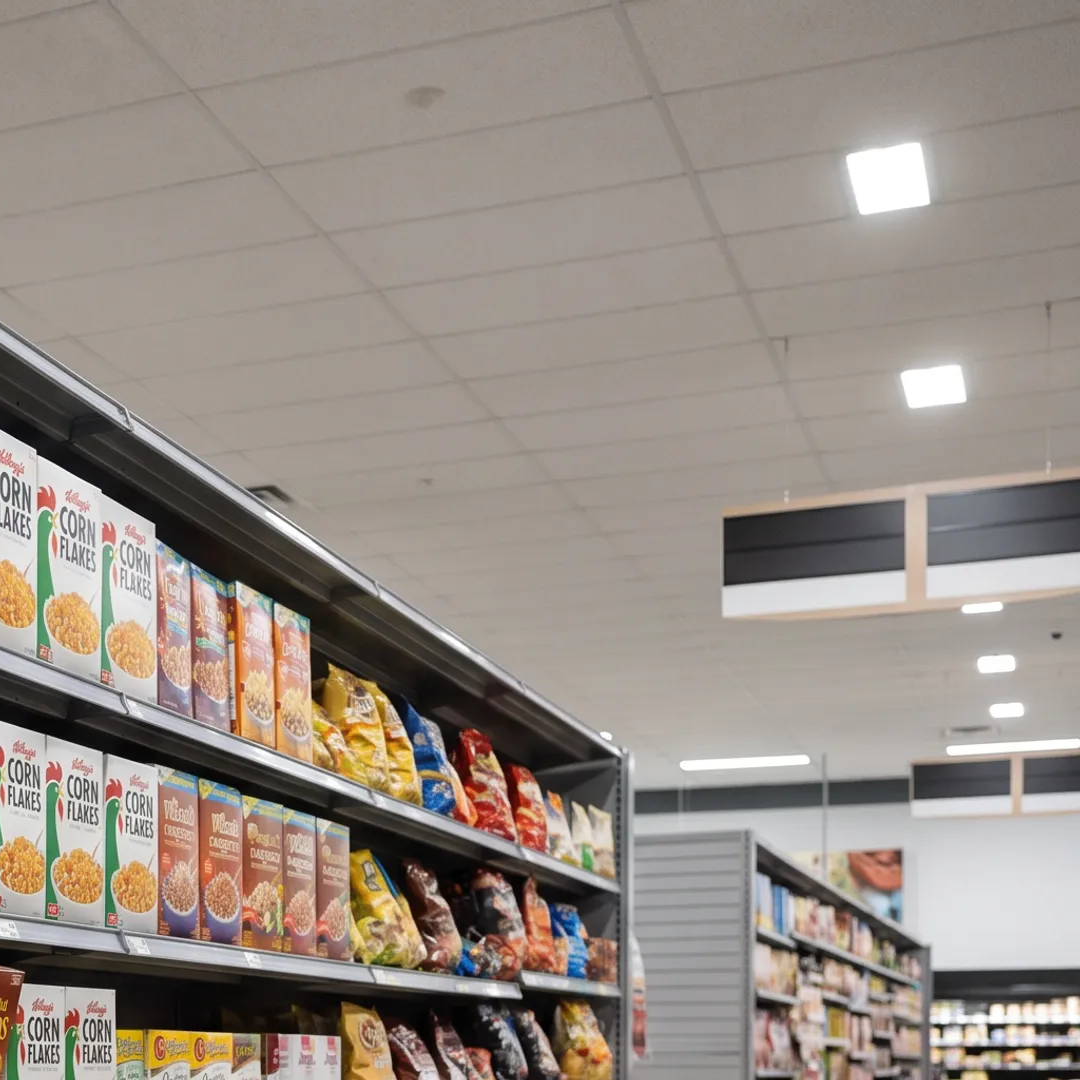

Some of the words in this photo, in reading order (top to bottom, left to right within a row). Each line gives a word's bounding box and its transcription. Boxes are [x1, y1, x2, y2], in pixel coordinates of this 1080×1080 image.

[59, 506, 96, 548] CORN
[60, 535, 96, 573] FLAKES
[120, 540, 151, 579] CORN
[120, 568, 152, 602] FLAKES
[7, 757, 41, 790] CORN
[8, 785, 42, 813] FLAKES
[67, 774, 99, 805] CORN
[67, 800, 100, 827] FLAKES
[125, 790, 153, 819] CORN
[125, 815, 154, 839] FLAKES
[27, 1016, 60, 1043] CORN
[82, 1017, 112, 1043] CORN
[27, 1043, 60, 1065] FLAKES
[82, 1043, 112, 1064] FLAKES
